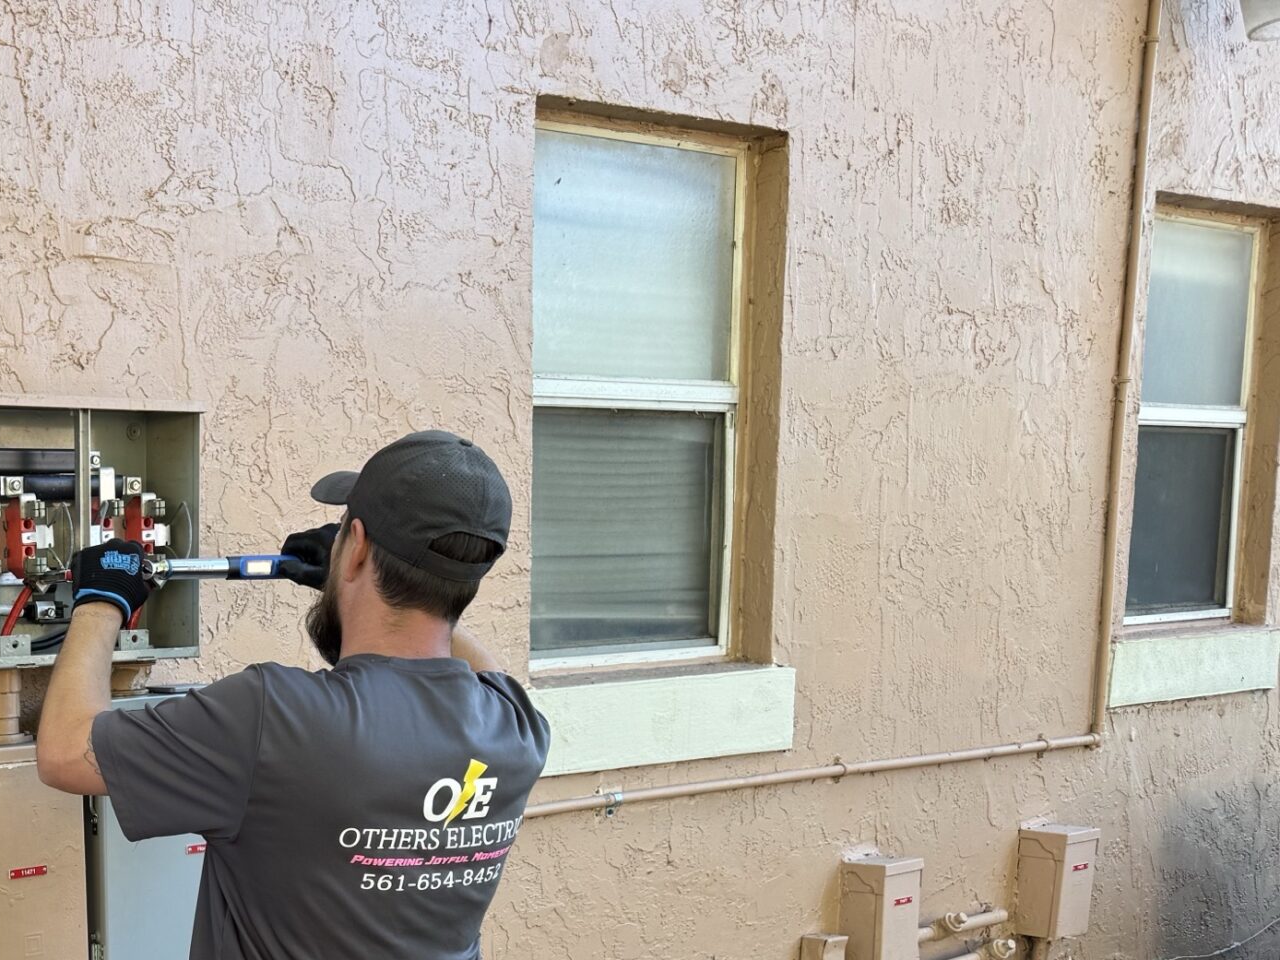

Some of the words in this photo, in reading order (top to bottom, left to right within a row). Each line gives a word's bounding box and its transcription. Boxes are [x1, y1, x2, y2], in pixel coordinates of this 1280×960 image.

[338, 827, 440, 850] OTHERS
[350, 854, 423, 867] POWERING
[424, 855, 469, 866] JOYFUL
[360, 863, 502, 892] 561-654-8452
